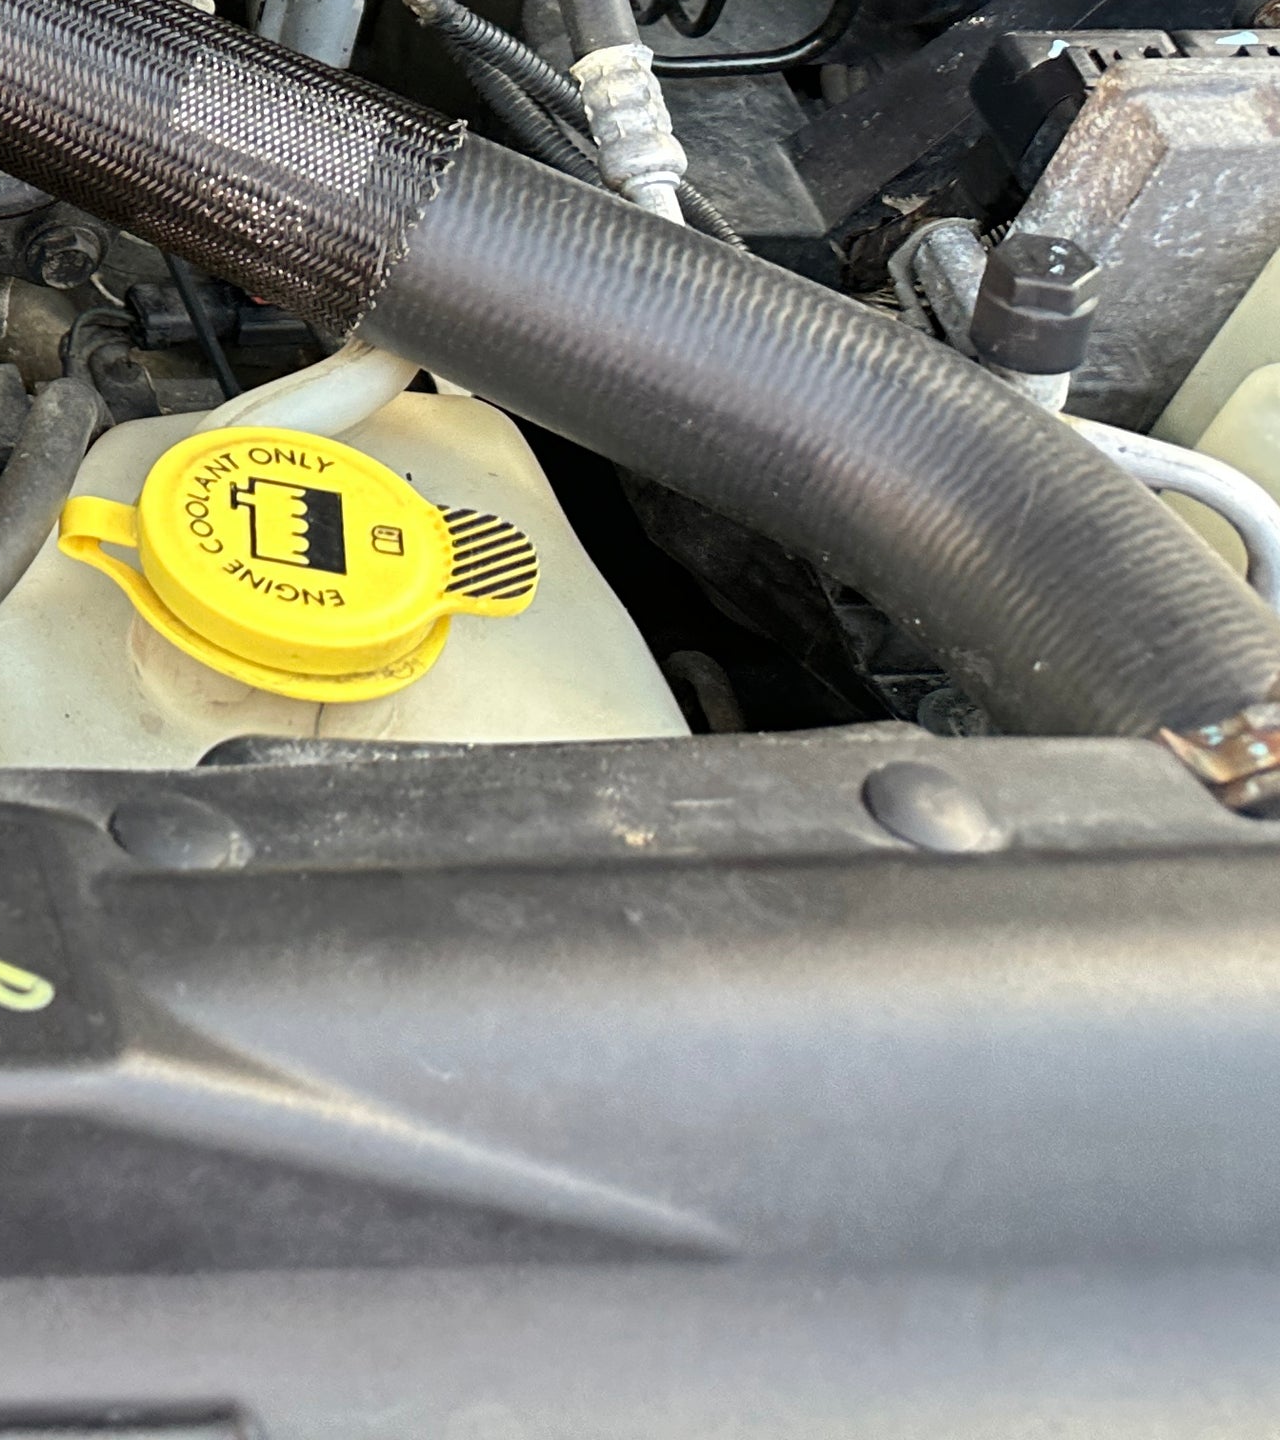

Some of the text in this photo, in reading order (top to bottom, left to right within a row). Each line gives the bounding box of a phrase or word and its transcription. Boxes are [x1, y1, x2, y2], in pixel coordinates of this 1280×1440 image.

[183, 447, 346, 608] ENGINE COOLANT ONLY
